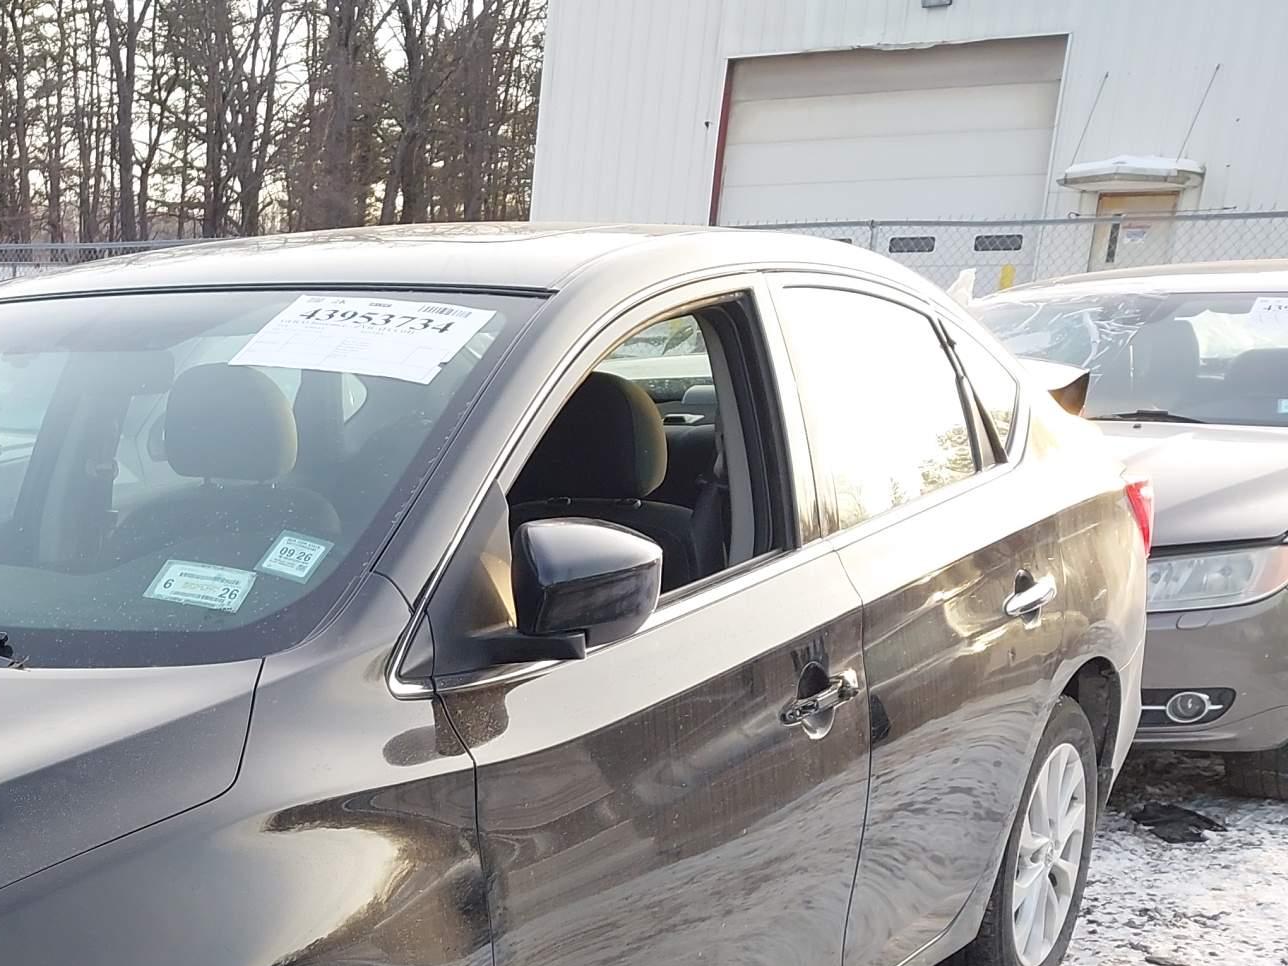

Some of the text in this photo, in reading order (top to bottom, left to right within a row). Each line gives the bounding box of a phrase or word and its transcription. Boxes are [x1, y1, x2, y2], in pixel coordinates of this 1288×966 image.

[299, 308, 455, 334] 43953734
[296, 551, 313, 562] 26
[163, 578, 175, 589] 6
[218, 587, 240, 600] 26
